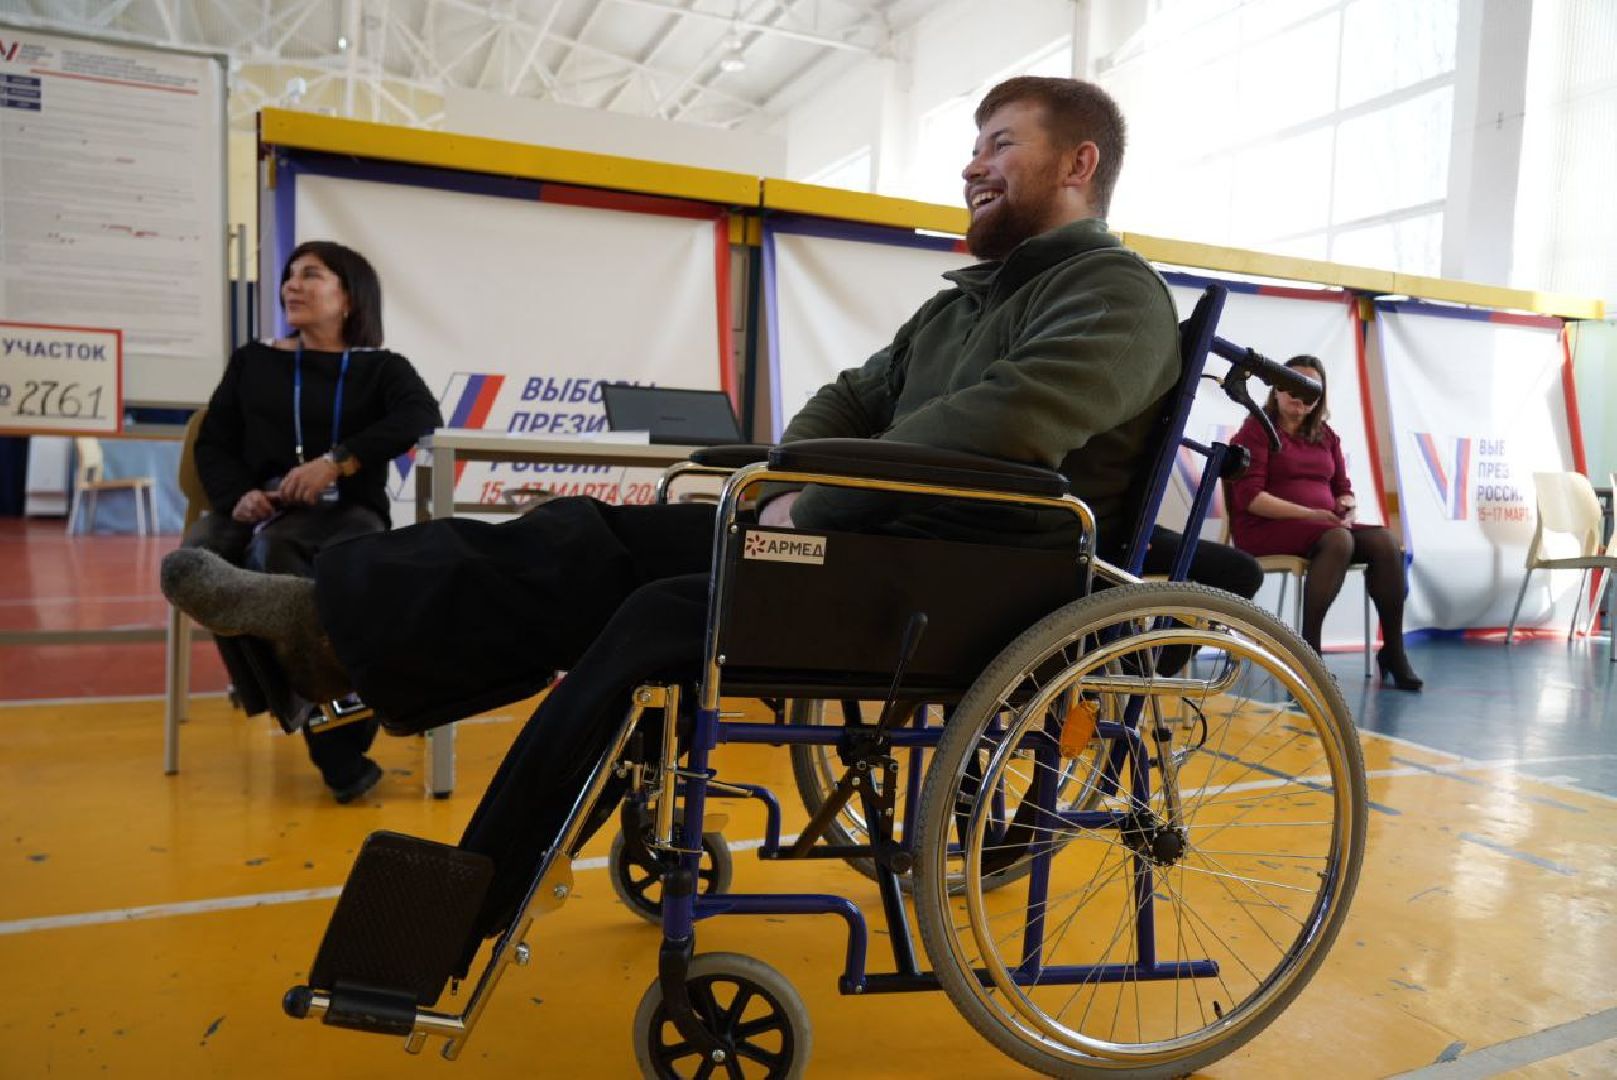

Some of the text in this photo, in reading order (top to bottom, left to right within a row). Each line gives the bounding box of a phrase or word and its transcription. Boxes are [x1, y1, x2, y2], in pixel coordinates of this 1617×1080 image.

[2, 338, 107, 361] УЧАСТОК
[16, 380, 104, 418] 2761
[520, 376, 656, 403] ВЫБО
[507, 411, 608, 433] ПРЕЗИ
[1479, 439, 1506, 457] ВЫБ
[1478, 462, 1510, 479] ПРЕЗ
[1477, 486, 1524, 503] РОССИ
[767, 539, 824, 558] АРМЕД
